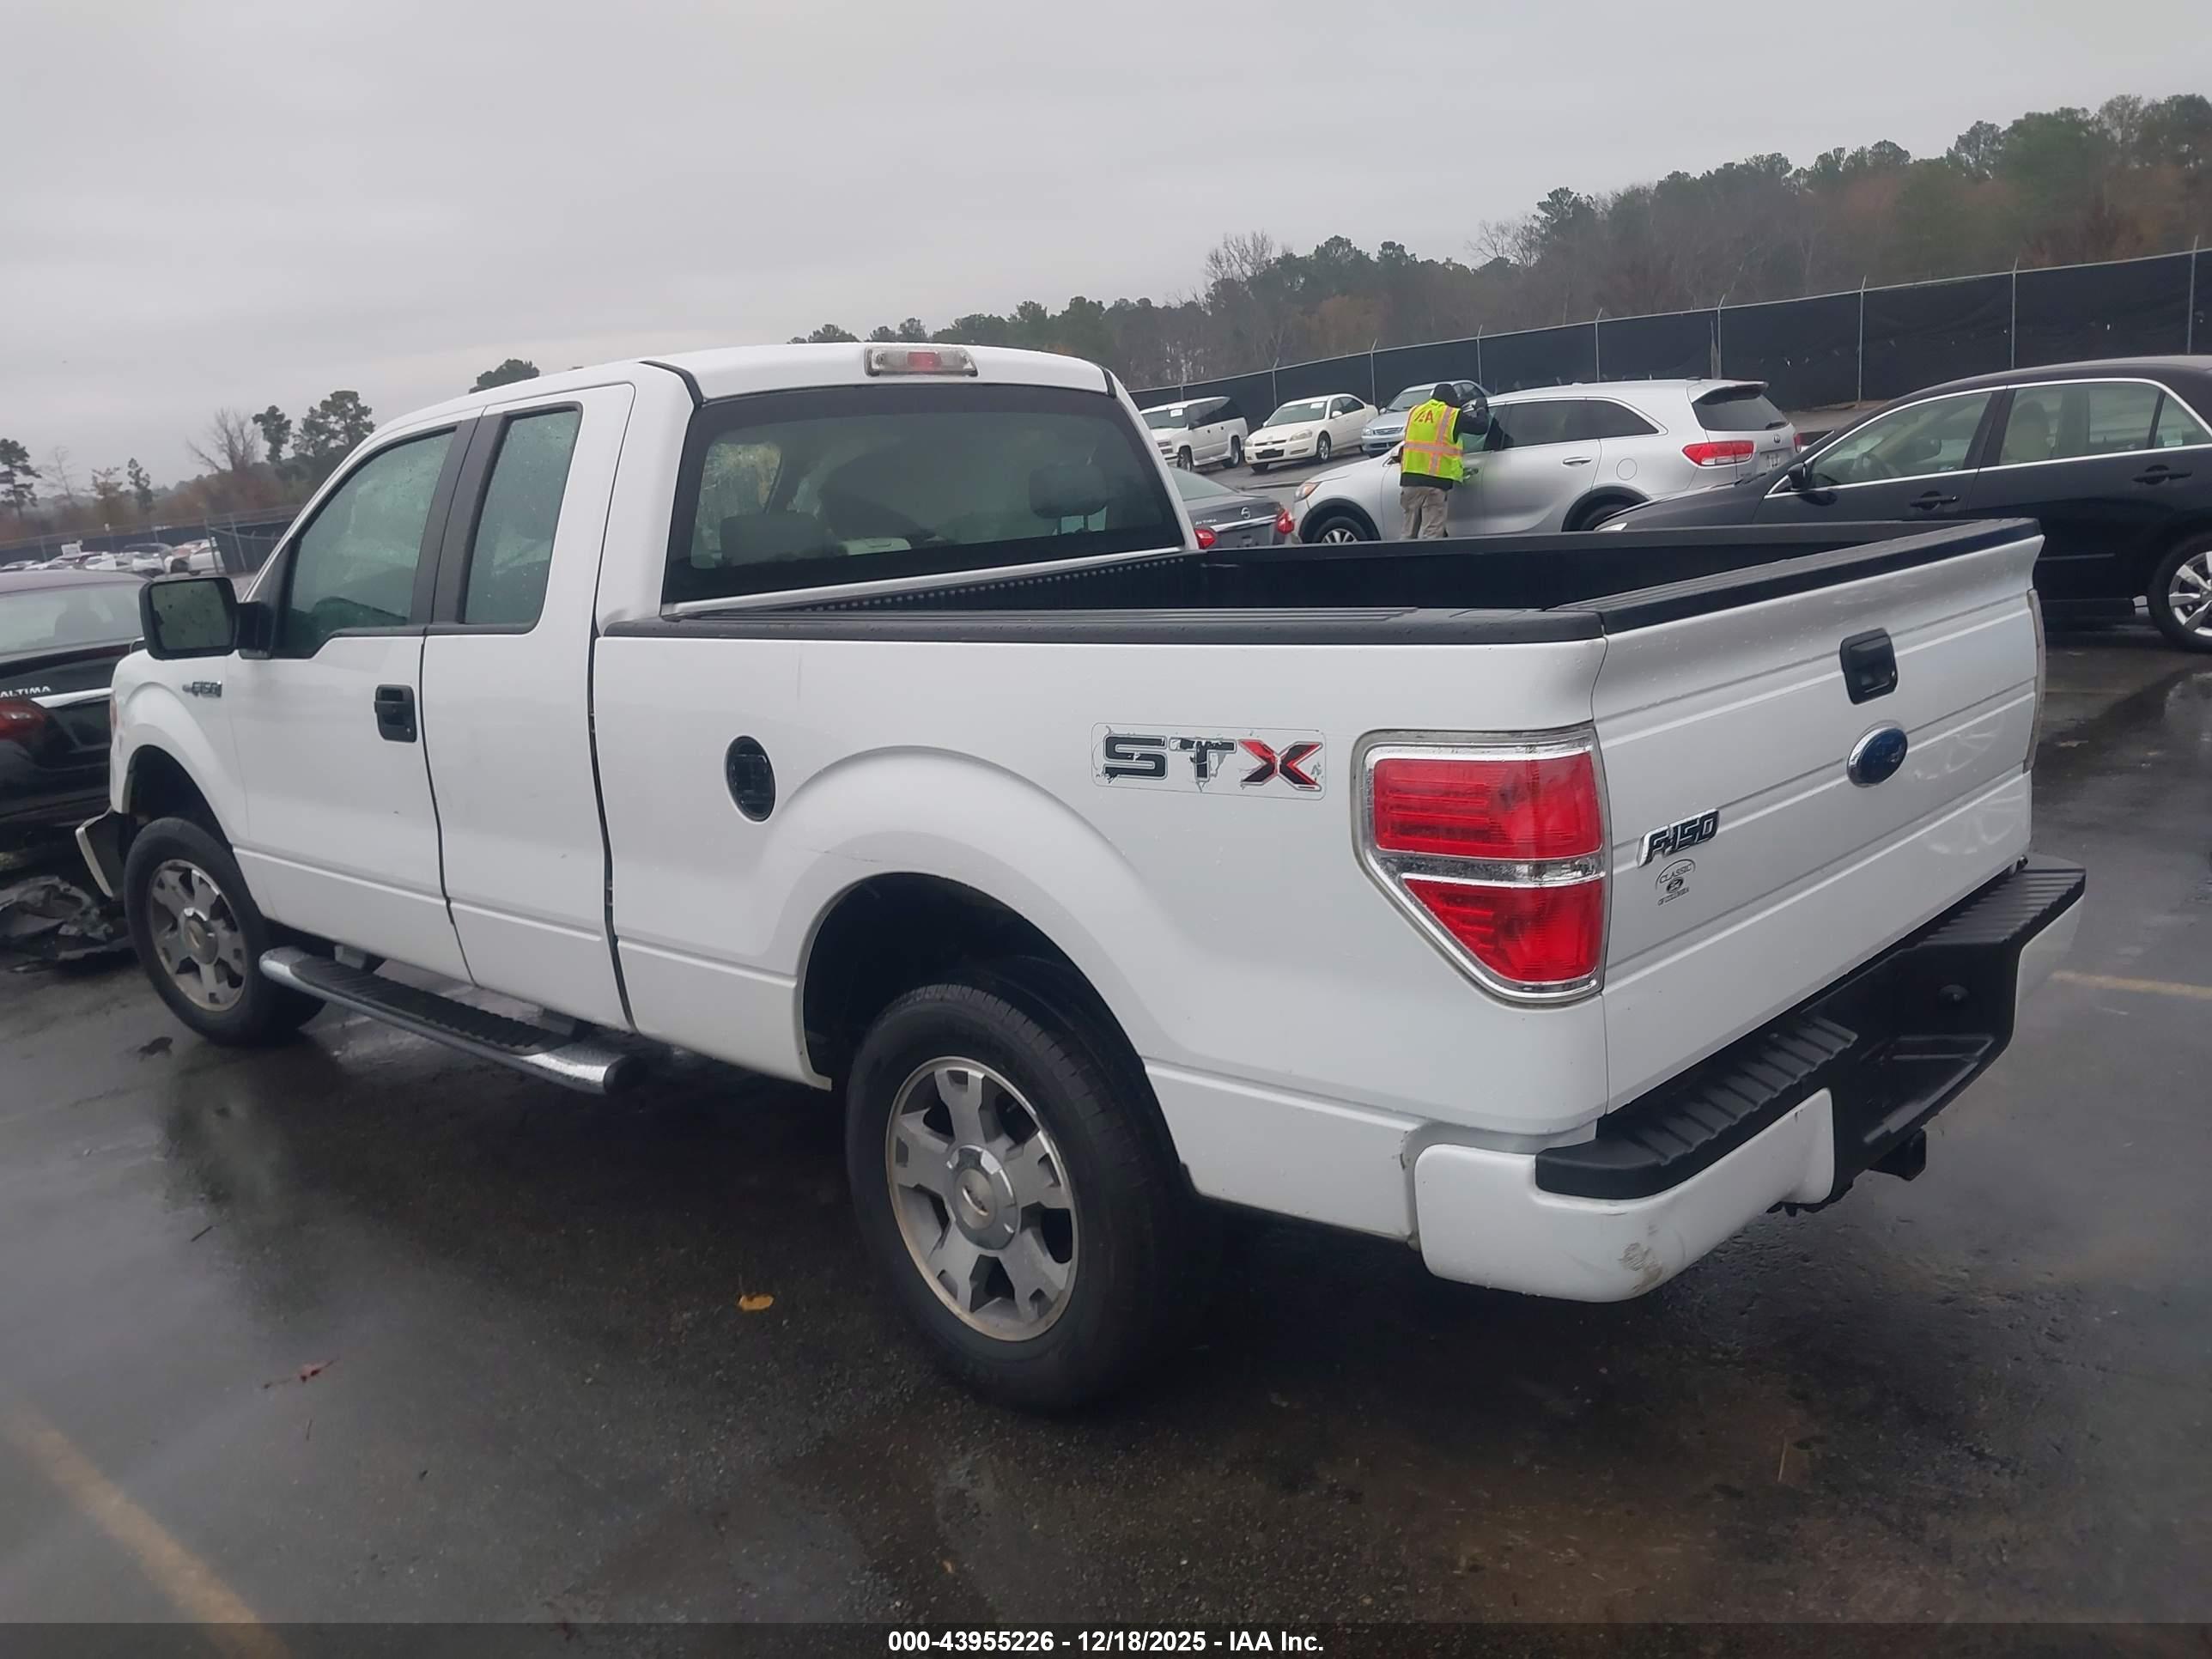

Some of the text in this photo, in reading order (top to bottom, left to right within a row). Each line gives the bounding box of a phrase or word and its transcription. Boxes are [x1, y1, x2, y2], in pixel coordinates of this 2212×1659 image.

[0, 685, 52, 698] ALTIMA
[1103, 734, 1323, 792] STX
[1659, 863, 1692, 884] CLASSIC
